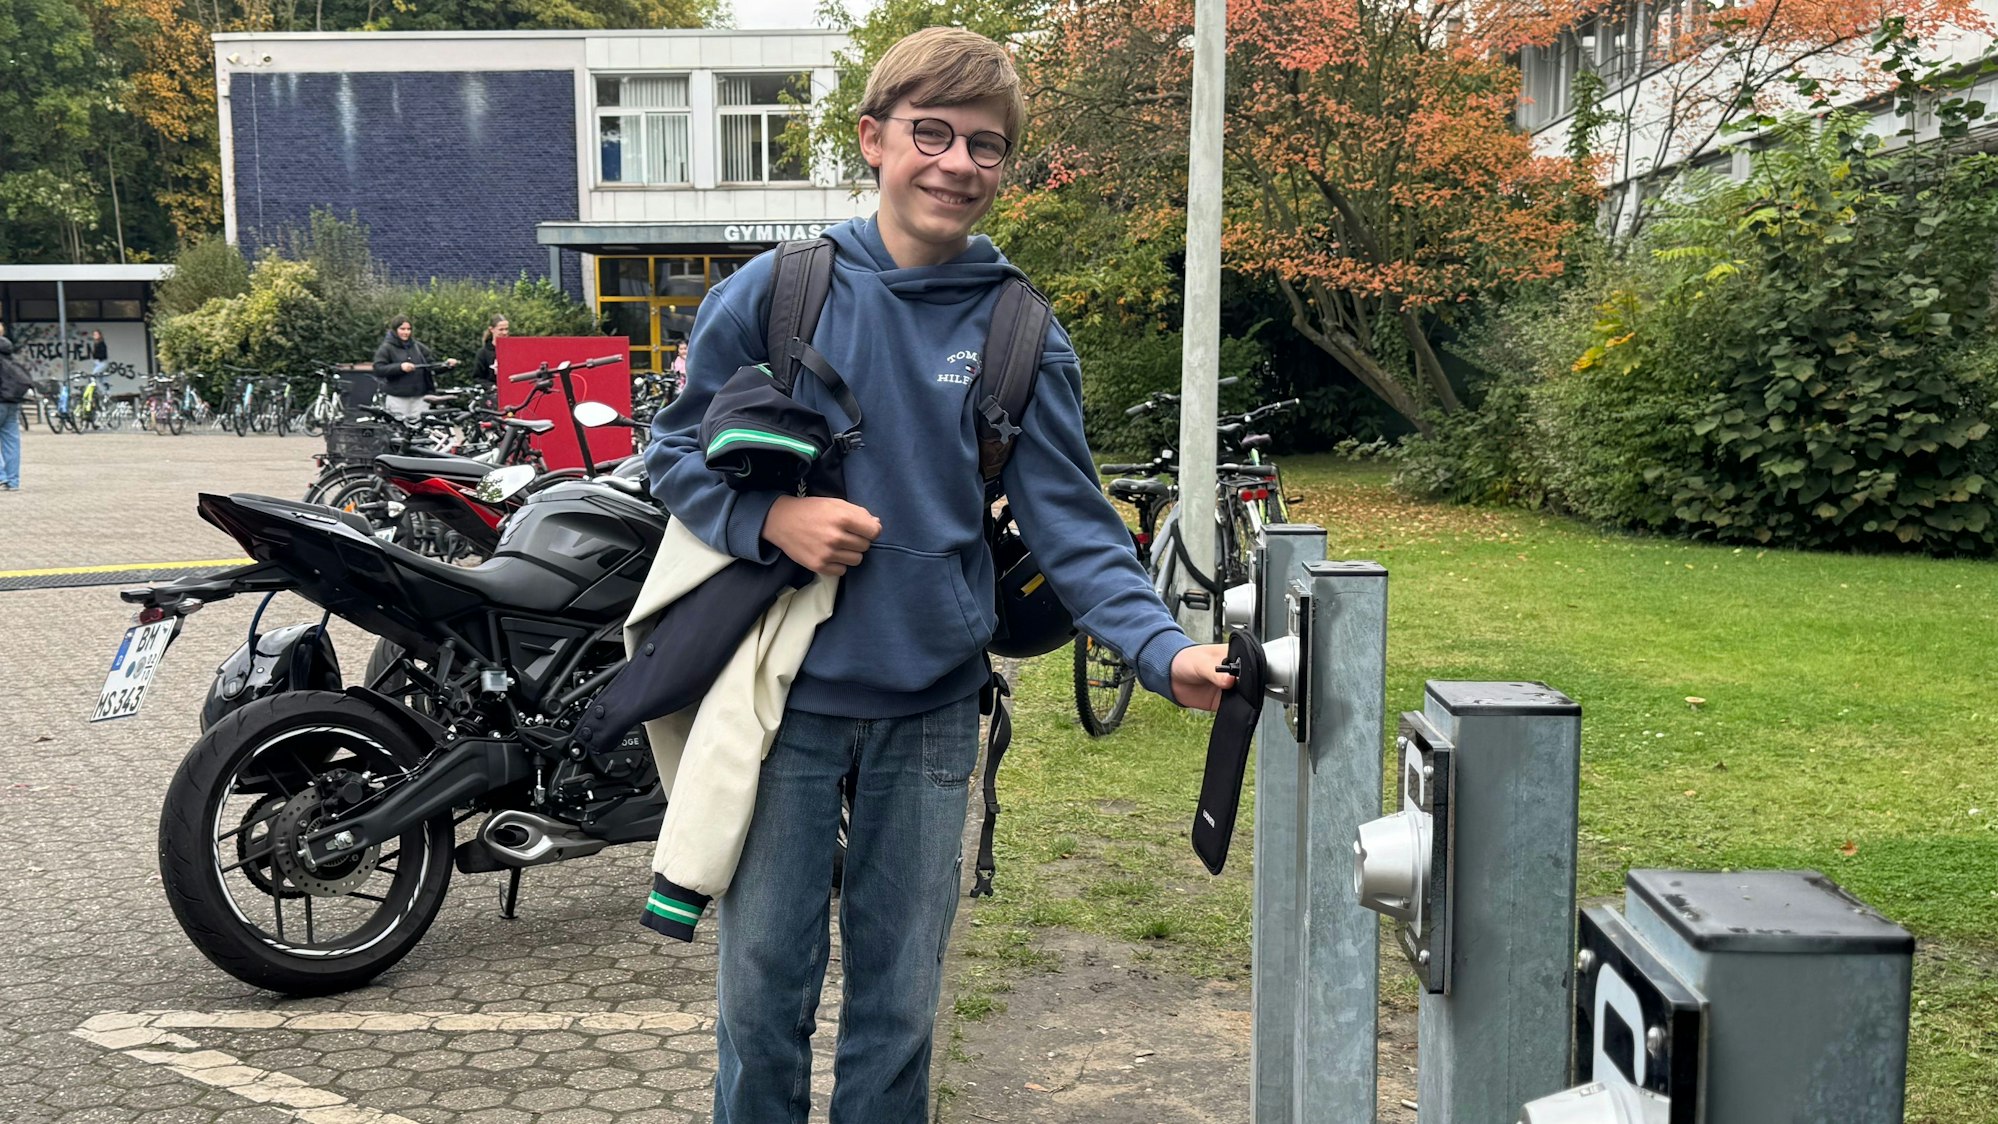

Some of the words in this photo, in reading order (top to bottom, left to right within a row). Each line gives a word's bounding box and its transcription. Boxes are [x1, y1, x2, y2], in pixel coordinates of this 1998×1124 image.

[724, 225, 830, 240] GYMNAS
[136, 624, 161, 653] BM
[621, 737, 640, 747] OGE
